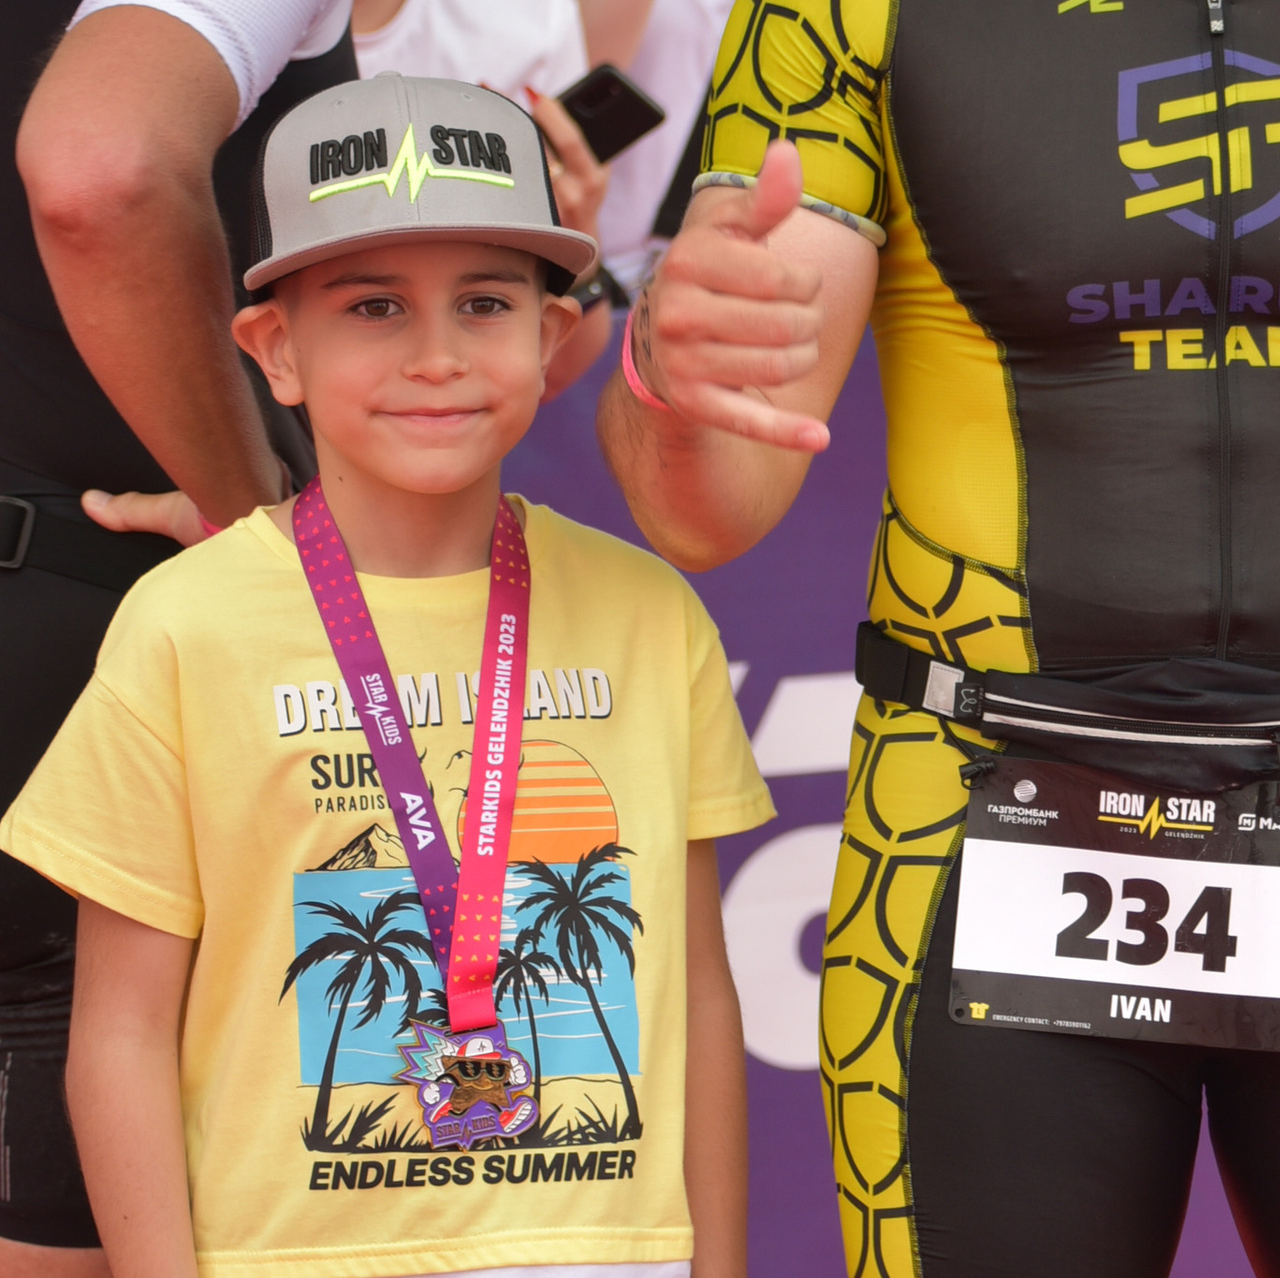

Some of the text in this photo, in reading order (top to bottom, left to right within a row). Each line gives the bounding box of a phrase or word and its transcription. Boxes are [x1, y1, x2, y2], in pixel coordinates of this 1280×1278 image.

[309, 124, 512, 185] IRON STAR
[366, 673, 403, 746] STAR KIDS
[455, 667, 612, 725] IAND
[477, 613, 517, 856] STARKIDS GELENDZHIK 2023
[310, 752, 386, 791] SUR
[400, 791, 436, 851] AVA
[987, 804, 1059, 820] ГАЗПРОМБАНК
[998, 814, 1047, 827] ПРЕМИУМ
[1099, 790, 1216, 823] IRON STAR
[1119, 826, 1137, 834] 2023
[1164, 830, 1205, 840] GELENDZHIK
[1054, 871, 1238, 973] 234
[1110, 994, 1172, 1023] IVAN
[437, 1115, 497, 1138] STAR KIDS
[309, 1149, 637, 1191] ENDLESS SUMMER
